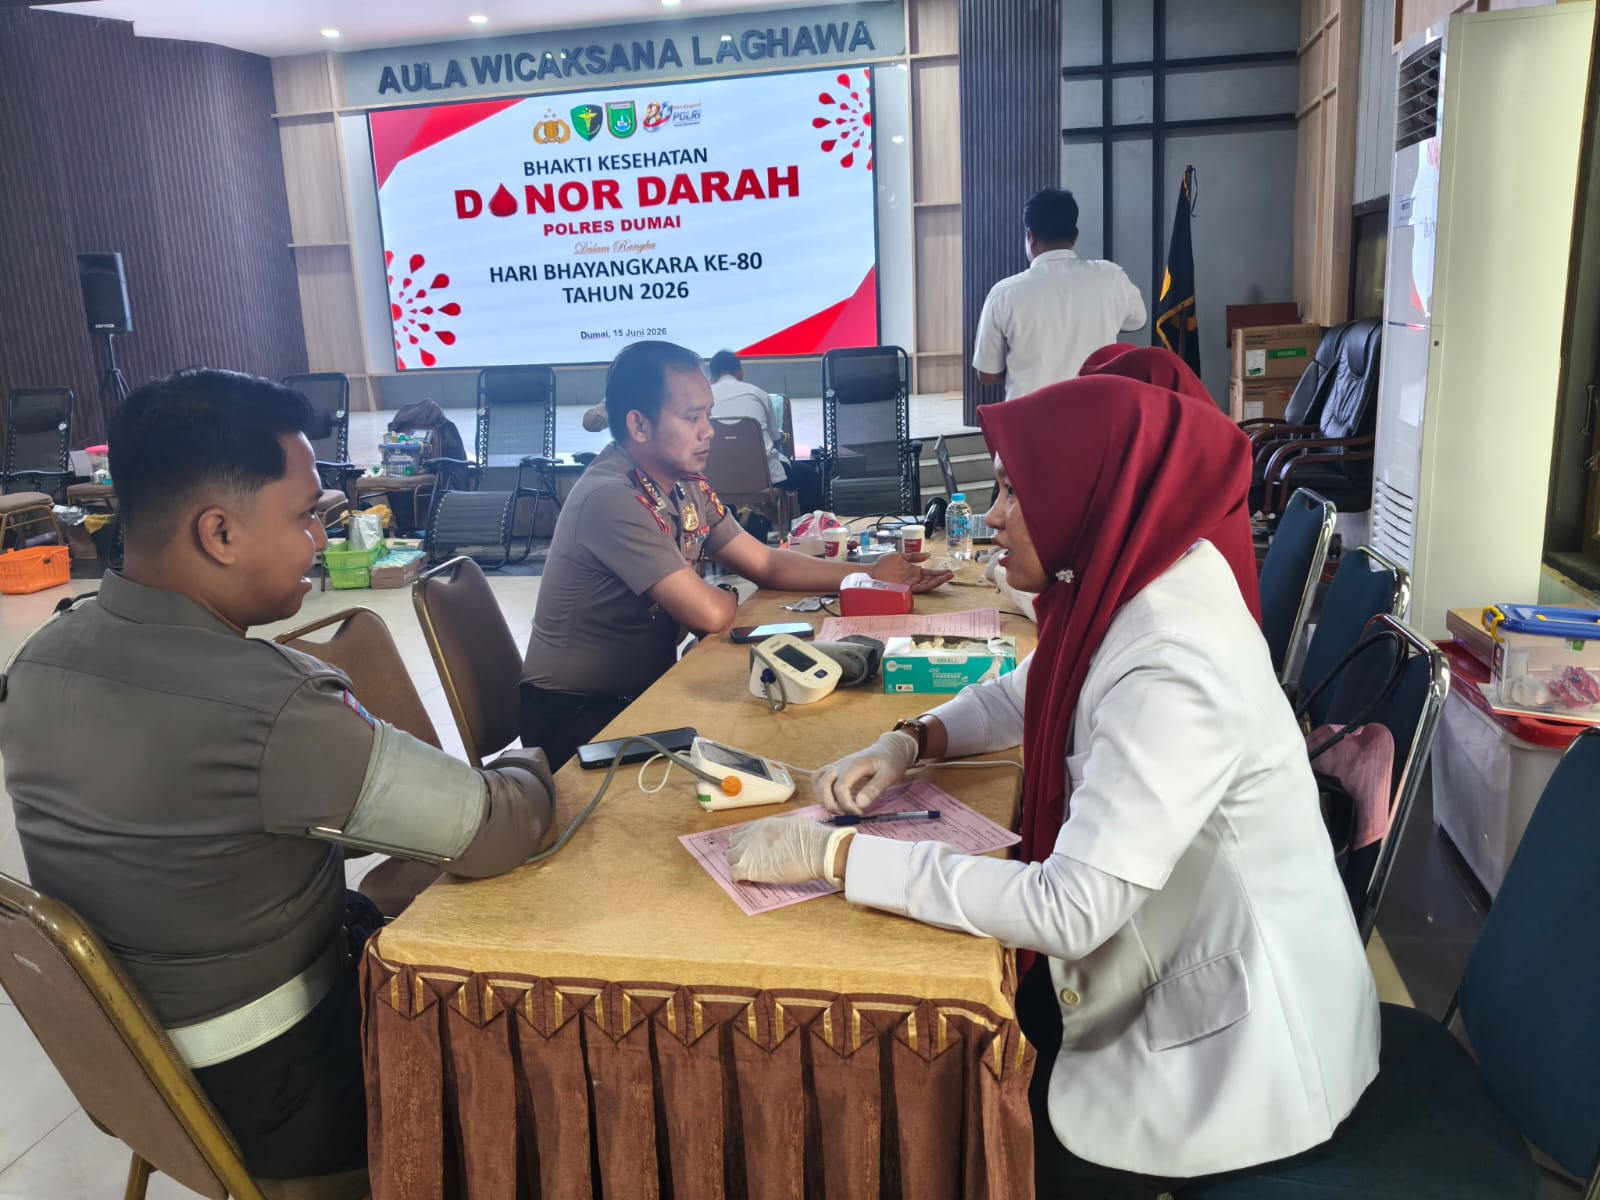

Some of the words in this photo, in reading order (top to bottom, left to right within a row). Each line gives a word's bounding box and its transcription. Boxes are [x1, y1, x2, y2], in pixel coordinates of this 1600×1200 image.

[378, 59, 468, 95] AULA
[471, 37, 683, 85] WICAKSANA
[692, 20, 875, 66] LAGHAWA
[523, 157, 593, 177] BHAKTI
[598, 147, 708, 169] KESEHATAN
[637, 165, 800, 207] DARAH
[543, 220, 615, 237] POLRES
[621, 215, 682, 232] DUMAI
[490, 265, 537, 284] HARI
[544, 256, 699, 280] BHAYANGKARA
[704, 251, 763, 272] KE-80
[562, 284, 634, 304] TAHUN
[640, 281, 690, 300] 2026
[613, 329, 623, 337] 15
[626, 328, 645, 337] Juni
[647, 327, 667, 336] 2026
